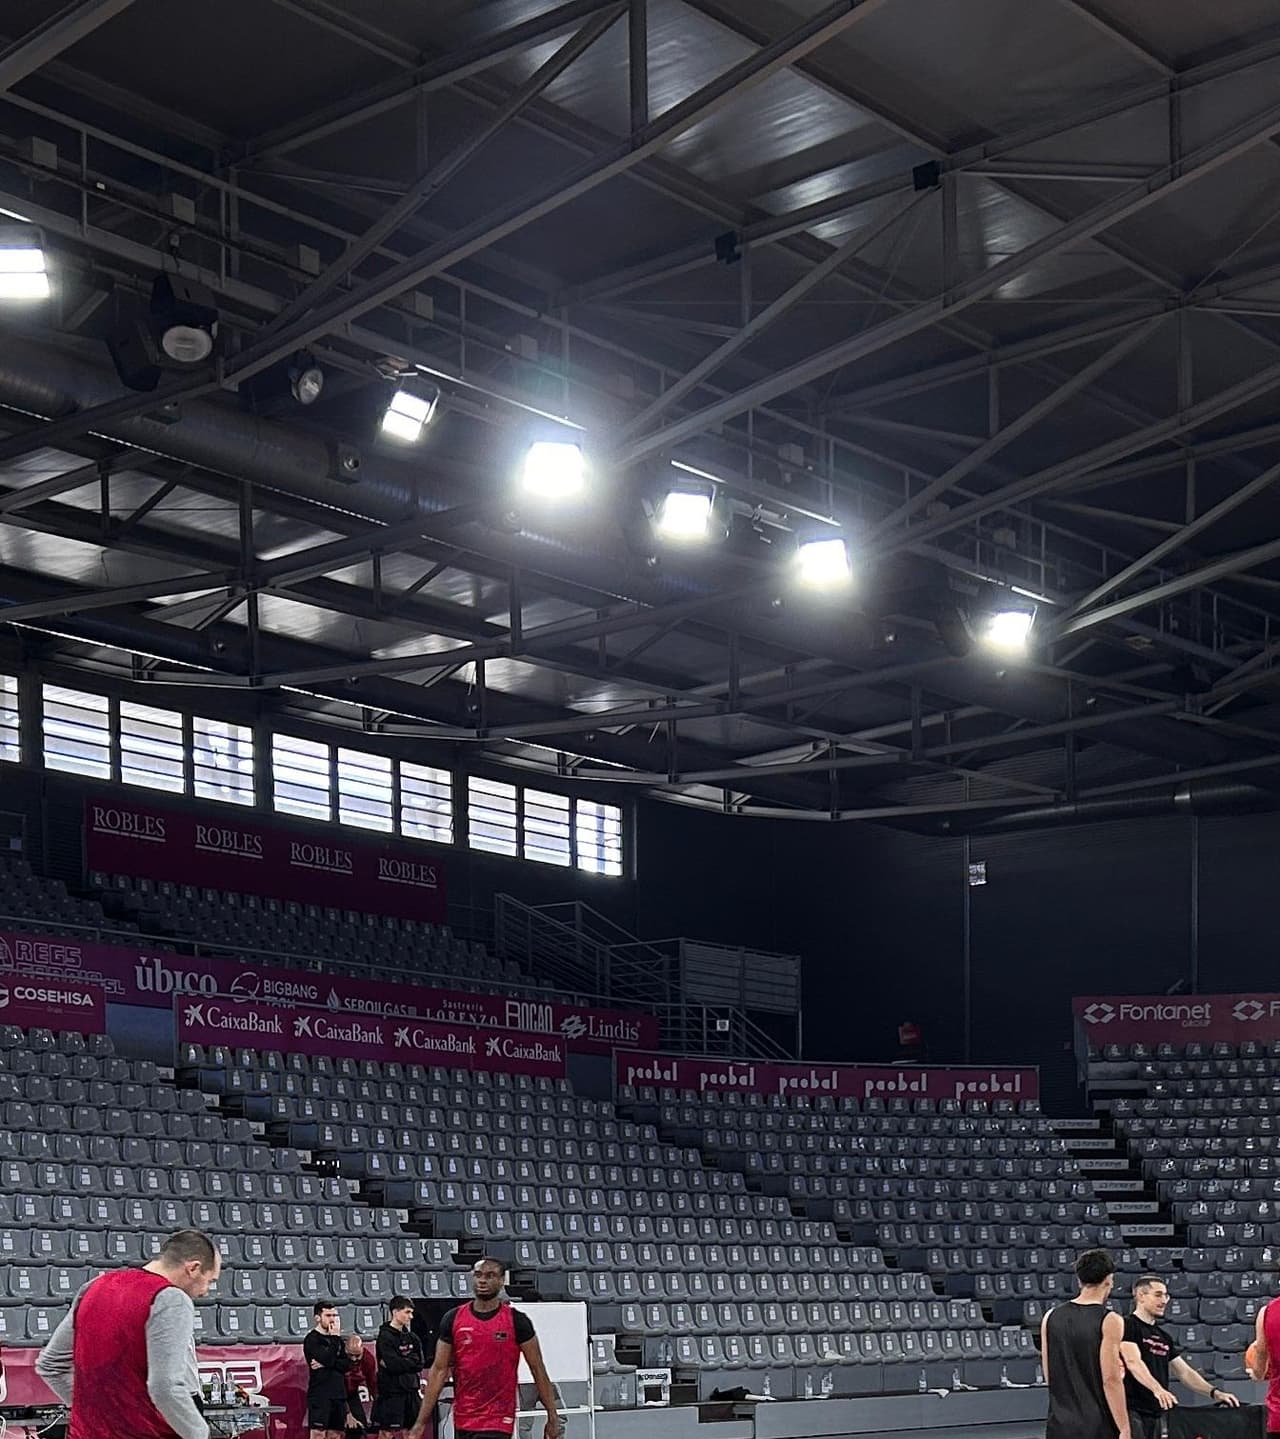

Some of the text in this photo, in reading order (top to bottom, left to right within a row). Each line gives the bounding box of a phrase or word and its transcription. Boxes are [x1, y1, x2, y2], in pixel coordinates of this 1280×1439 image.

[93, 806, 166, 837] ROBLES
[195, 824, 263, 853] ROBLES
[290, 841, 353, 869] ROBLES
[378, 857, 437, 884] ROBLES
[13, 986, 95, 1006] COSEHISA
[263, 980, 318, 999] BIGBANG
[207, 1007, 283, 1034] CaixaBank
[1119, 1003, 1211, 1020] Fontanet
[314, 1018, 384, 1045] CaixaBank
[588, 1015, 639, 1041] Lindis
[412, 1029, 477, 1054] CaixaBank
[503, 1039, 562, 1062] CaixaBank
